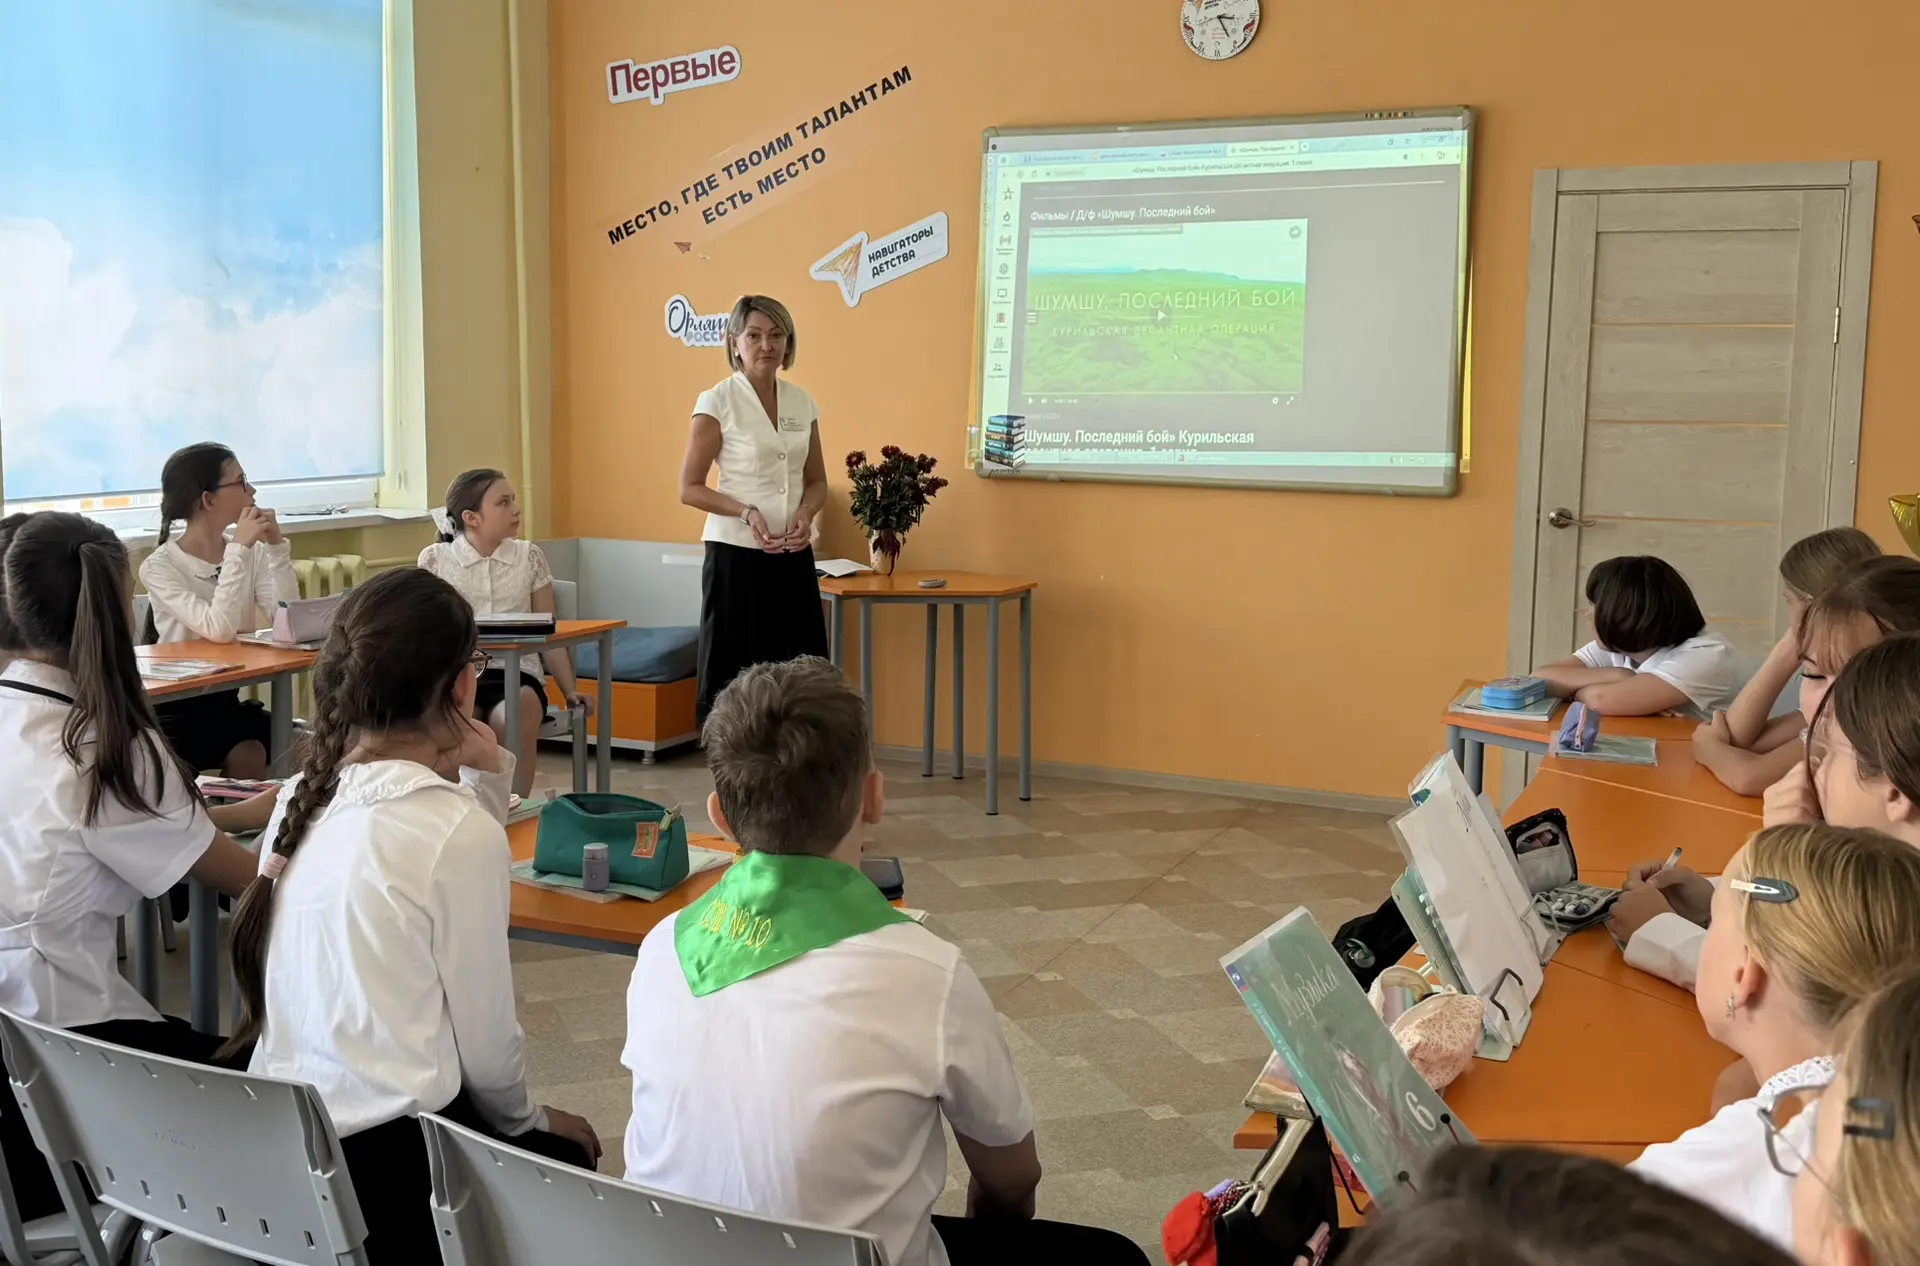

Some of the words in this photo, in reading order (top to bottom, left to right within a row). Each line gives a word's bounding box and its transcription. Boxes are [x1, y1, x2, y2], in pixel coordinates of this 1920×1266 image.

[610, 49, 737, 99] Первые
[607, 199, 680, 246] МЕСТО,
[681, 174, 721, 204] ГДЕ
[721, 131, 795, 181] ТВОИМ
[796, 64, 913, 140] ТАЛАНТАМ
[701, 189, 755, 226] ЕСТЬ
[756, 146, 827, 194] МЕСТО
[1030, 210, 1069, 222] Фильмы
[1076, 209, 1096, 222] Д/ф
[1097, 208, 1138, 222] «Шумшу.
[1139, 206, 1192, 218] Последний
[1193, 205, 1216, 217] бой»
[867, 224, 935, 265] НАВИГАТОРЫ
[871, 248, 917, 279] ДЕТСТВА
[668, 299, 729, 337] Орлят
[1034, 293, 1109, 312] ШУМШУ.
[1118, 288, 1241, 310] ПОСЛЕДНИЙ
[1251, 287, 1296, 307] БОЙ
[1051, 325, 1128, 337] КУРИЛЬСКАЯ
[1134, 324, 1204, 336] ДЕСАНТНАЯ
[1210, 323, 1276, 335] ОПЕРАЦИЯ
[1075, 430, 1144, 445] Последний
[1146, 429, 1176, 444] бой»
[1178, 429, 1255, 446] Курильская
[1405, 1091, 1437, 1132] 6
